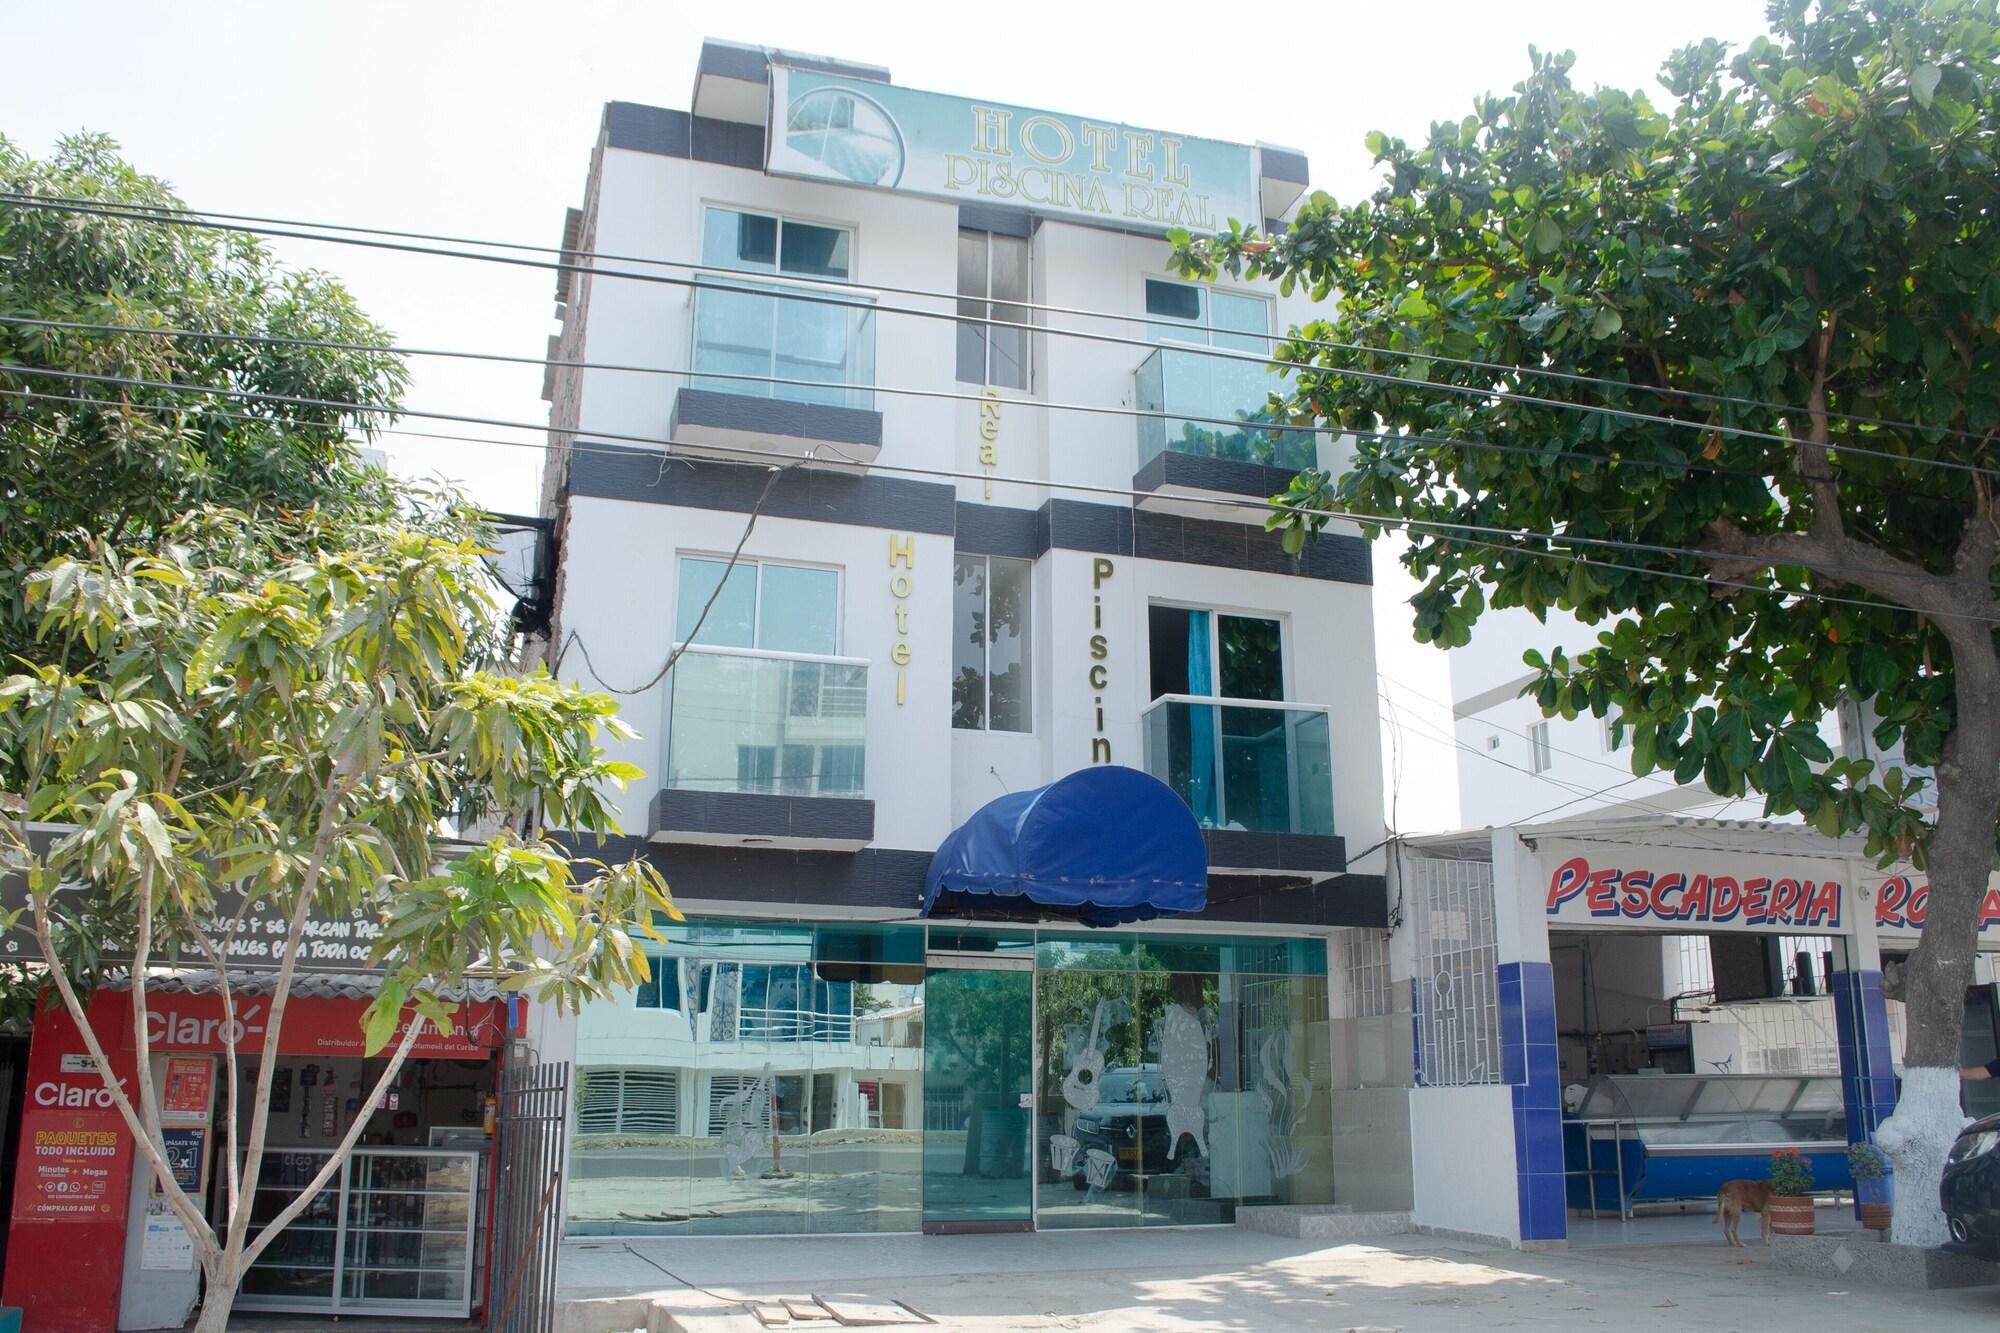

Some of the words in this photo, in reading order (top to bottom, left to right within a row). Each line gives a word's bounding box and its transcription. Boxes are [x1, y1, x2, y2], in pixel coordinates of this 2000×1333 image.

[972, 105, 1190, 187] HOTEL
[943, 154, 1113, 215] PISCINA
[1122, 183, 1217, 233] REAL
[978, 386, 1001, 500] Real
[889, 534, 914, 706] Hotel
[1546, 857, 1842, 928] PESCADERIA
[266, 918, 286, 935] SE
[289, 919, 351, 939] ARCAN
[272, 942, 307, 960] PAA
[310, 941, 348, 960] TODA
[144, 1009, 246, 1045] Claro
[35, 1081, 115, 1107] Claro
[34, 1146, 63, 1156] TODO
[65, 1146, 116, 1156] INCLUIDO
[35, 1130, 118, 1146] PAQUETES
[82, 1168, 108, 1177] Megas
